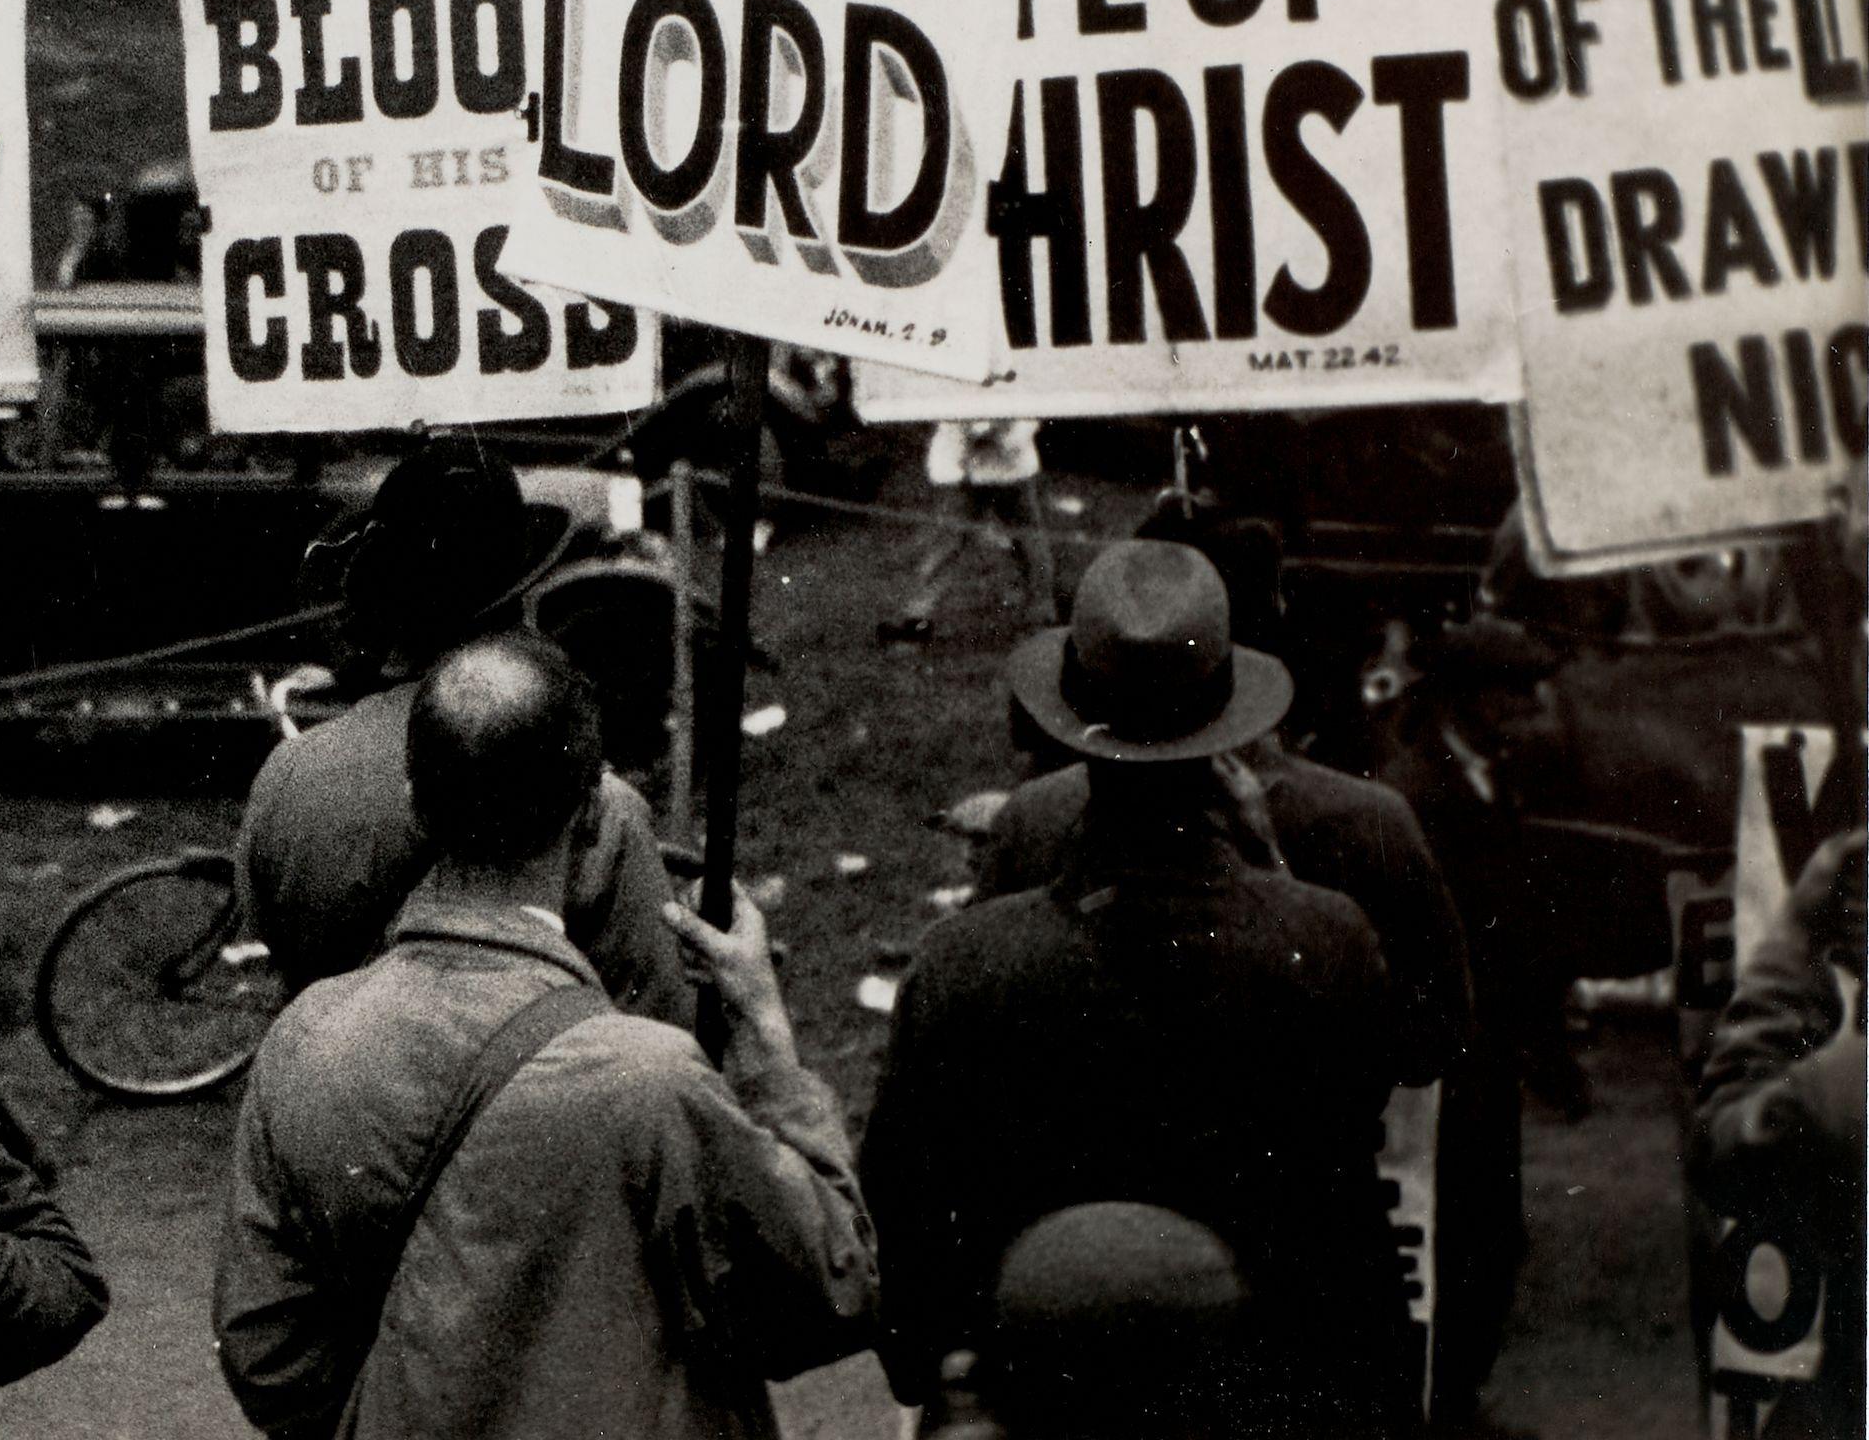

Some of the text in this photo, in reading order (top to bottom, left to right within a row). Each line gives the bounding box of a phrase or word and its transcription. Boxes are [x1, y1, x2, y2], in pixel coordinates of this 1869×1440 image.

[312, 146, 511, 196] OF HIS
[997, 50, 1471, 350] HRIST
[1539, 142, 1867, 316] DRAW
